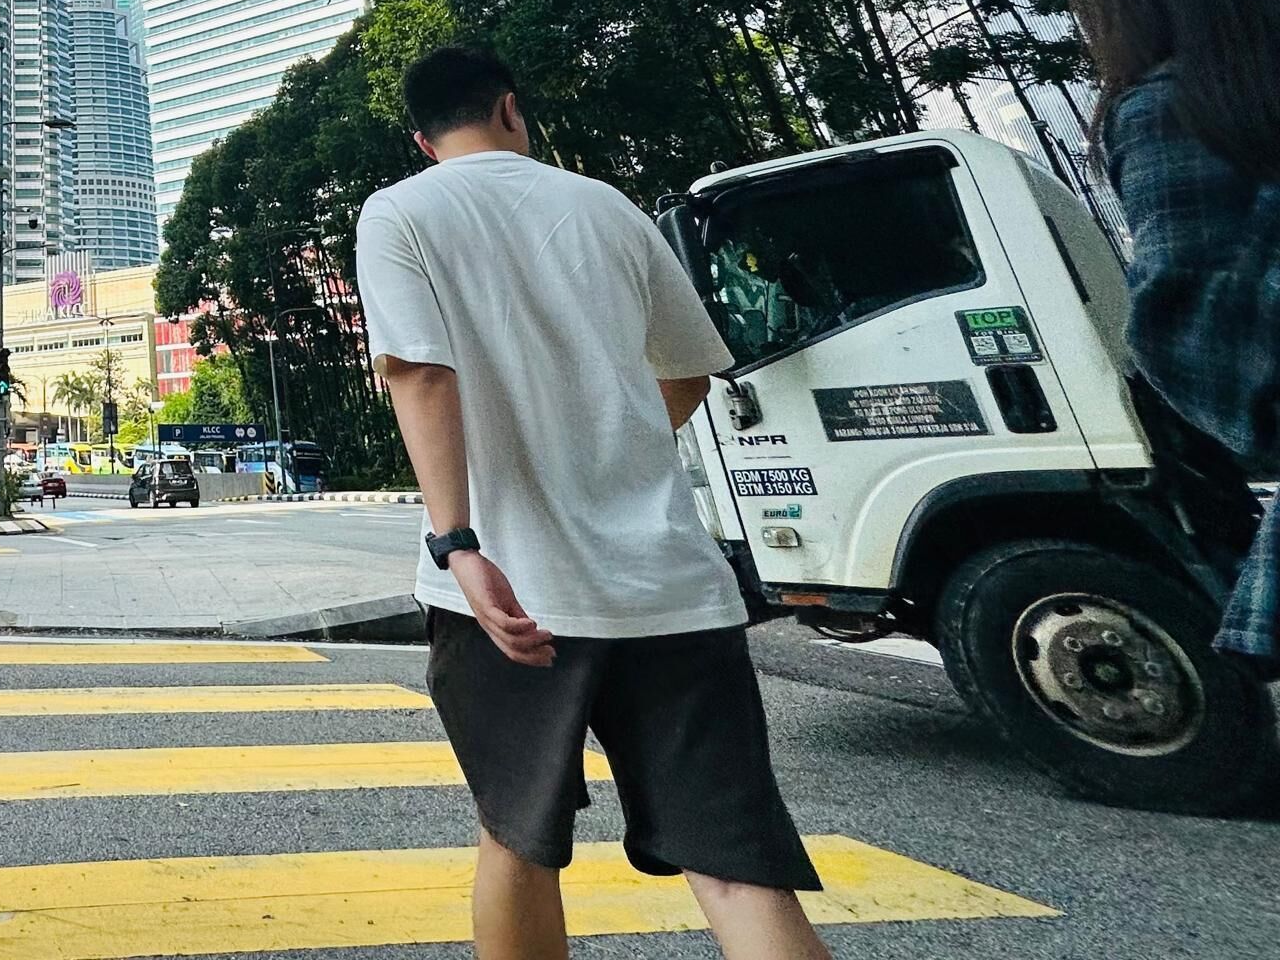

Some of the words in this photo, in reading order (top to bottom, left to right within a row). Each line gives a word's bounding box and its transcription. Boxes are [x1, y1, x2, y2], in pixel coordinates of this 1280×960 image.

[965, 311, 1012, 325] TOP
[202, 426, 221, 434] KLCC
[737, 434, 788, 447] NPR
[734, 470, 761, 483] BDM
[761, 469, 788, 482] 7500
[789, 469, 810, 481] KG
[738, 483, 765, 495] BTM
[765, 482, 793, 494] 3150
[793, 482, 813, 494] KG
[764, 509, 787, 518] EURO
